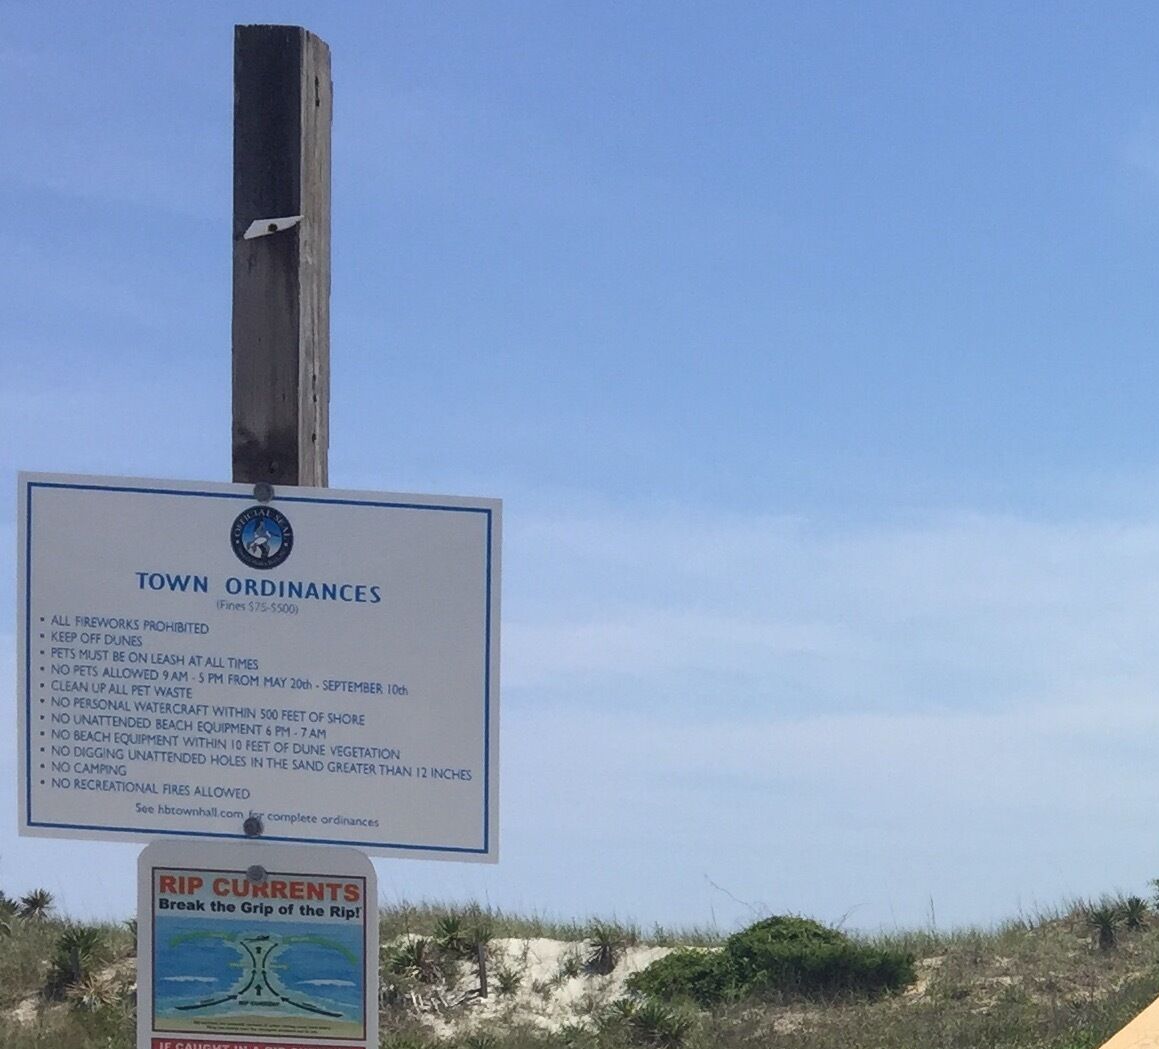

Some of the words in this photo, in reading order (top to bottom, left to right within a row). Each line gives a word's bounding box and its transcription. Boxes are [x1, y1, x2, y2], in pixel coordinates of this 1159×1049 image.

[134, 571, 208, 593] TOWN
[224, 576, 381, 603] ORDINANCES
[216, 600, 246, 612] (Fines
[50, 614, 70, 626] ALL
[75, 615, 139, 630] FIREWORKS
[143, 619, 209, 635] PROHIBITED
[50, 630, 77, 643] KEEP
[79, 632, 101, 644] OFF
[104, 633, 142, 647] DUNES
[50, 646, 75, 659] PETS
[79, 648, 108, 661] MUST
[112, 650, 124, 662] BE
[127, 651, 147, 663] ON
[150, 652, 184, 666] LEASH
[188, 654, 203, 666] AT
[204, 656, 224, 668] ALL
[227, 657, 258, 670] TIMES
[50, 663, 70, 675] NO
[73, 664, 98, 677] PETS
[102, 666, 158, 681] ALLOWED
[162, 669, 168, 680] 9
[170, 670, 188, 682] AM
[198, 671, 204, 683] 5
[207, 672, 223, 684] PM
[227, 673, 259, 686] FROM
[263, 675, 287, 688] MAY
[289, 677, 312, 690] 20th
[322, 679, 383, 694] SEPTEMBER
[387, 683, 408, 695] 10th
[50, 679, 88, 693] CLEAN
[91, 681, 106, 694] UP
[107, 683, 128, 695] ALL
[131, 684, 151, 696] PET
[153, 685, 192, 699] WASTE
[50, 695, 70, 708] NO
[72, 696, 131, 711] PERSONAL
[134, 700, 209, 716] WATERCRAFT
[211, 705, 256, 718] WITHIN
[259, 708, 278, 720] 500
[281, 709, 307, 722] FEET
[308, 711, 325, 723] OF
[326, 712, 365, 726] SHORE
[50, 711, 70, 724] NO
[73, 713, 151, 729] UNATTENDED
[155, 718, 193, 732] BEACH
[196, 720, 263, 737] EQUIPMENT
[265, 725, 271, 736] 6
[274, 725, 290, 737] PM
[300, 726, 307, 737] 7
[308, 728, 326, 739] AM
[50, 728, 70, 740] NO
[73, 729, 110, 743] BEACH
[114, 731, 178, 748] EQUIPMENT
[182, 735, 226, 749] WITHIN
[231, 739, 242, 750] 10
[245, 739, 270, 752] FEET
[273, 741, 288, 753] OF
[292, 742, 325, 755] DUNE
[330, 744, 400, 760] VEGETATION
[50, 744, 70, 756] NO
[73, 745, 124, 759] DIGGING
[127, 748, 206, 765] UNATTENDED
[209, 753, 247, 767] HOLES
[250, 756, 263, 768] IN
[266, 757, 288, 770] THE
[291, 759, 324, 772] SAND
[326, 760, 376, 775] GREATER
[378, 764, 411, 777] THAN
[416, 766, 427, 778] 12
[430, 767, 472, 781] INCHES
[51, 760, 70, 773] NO
[73, 761, 126, 776] CAMPING
[51, 776, 70, 789] NO
[73, 777, 159, 794] RECREATIONAL
[162, 783, 190, 796] FIRES
[193, 785, 250, 800] ALLOWED
[135, 802, 154, 814] See
[157, 804, 243, 819] hbtownhall.com
[248, 809, 264, 820] for
[267, 810, 317, 826] complete
[320, 814, 379, 827] ordinances
[159, 875, 203, 895] RIP
[212, 877, 359, 902] CURRENTS
[158, 897, 205, 911] Break
[210, 900, 235, 912] the
[240, 901, 273, 916] Grip
[277, 903, 293, 915] of
[298, 904, 324, 916] the
[329, 905, 359, 920] Rip!
